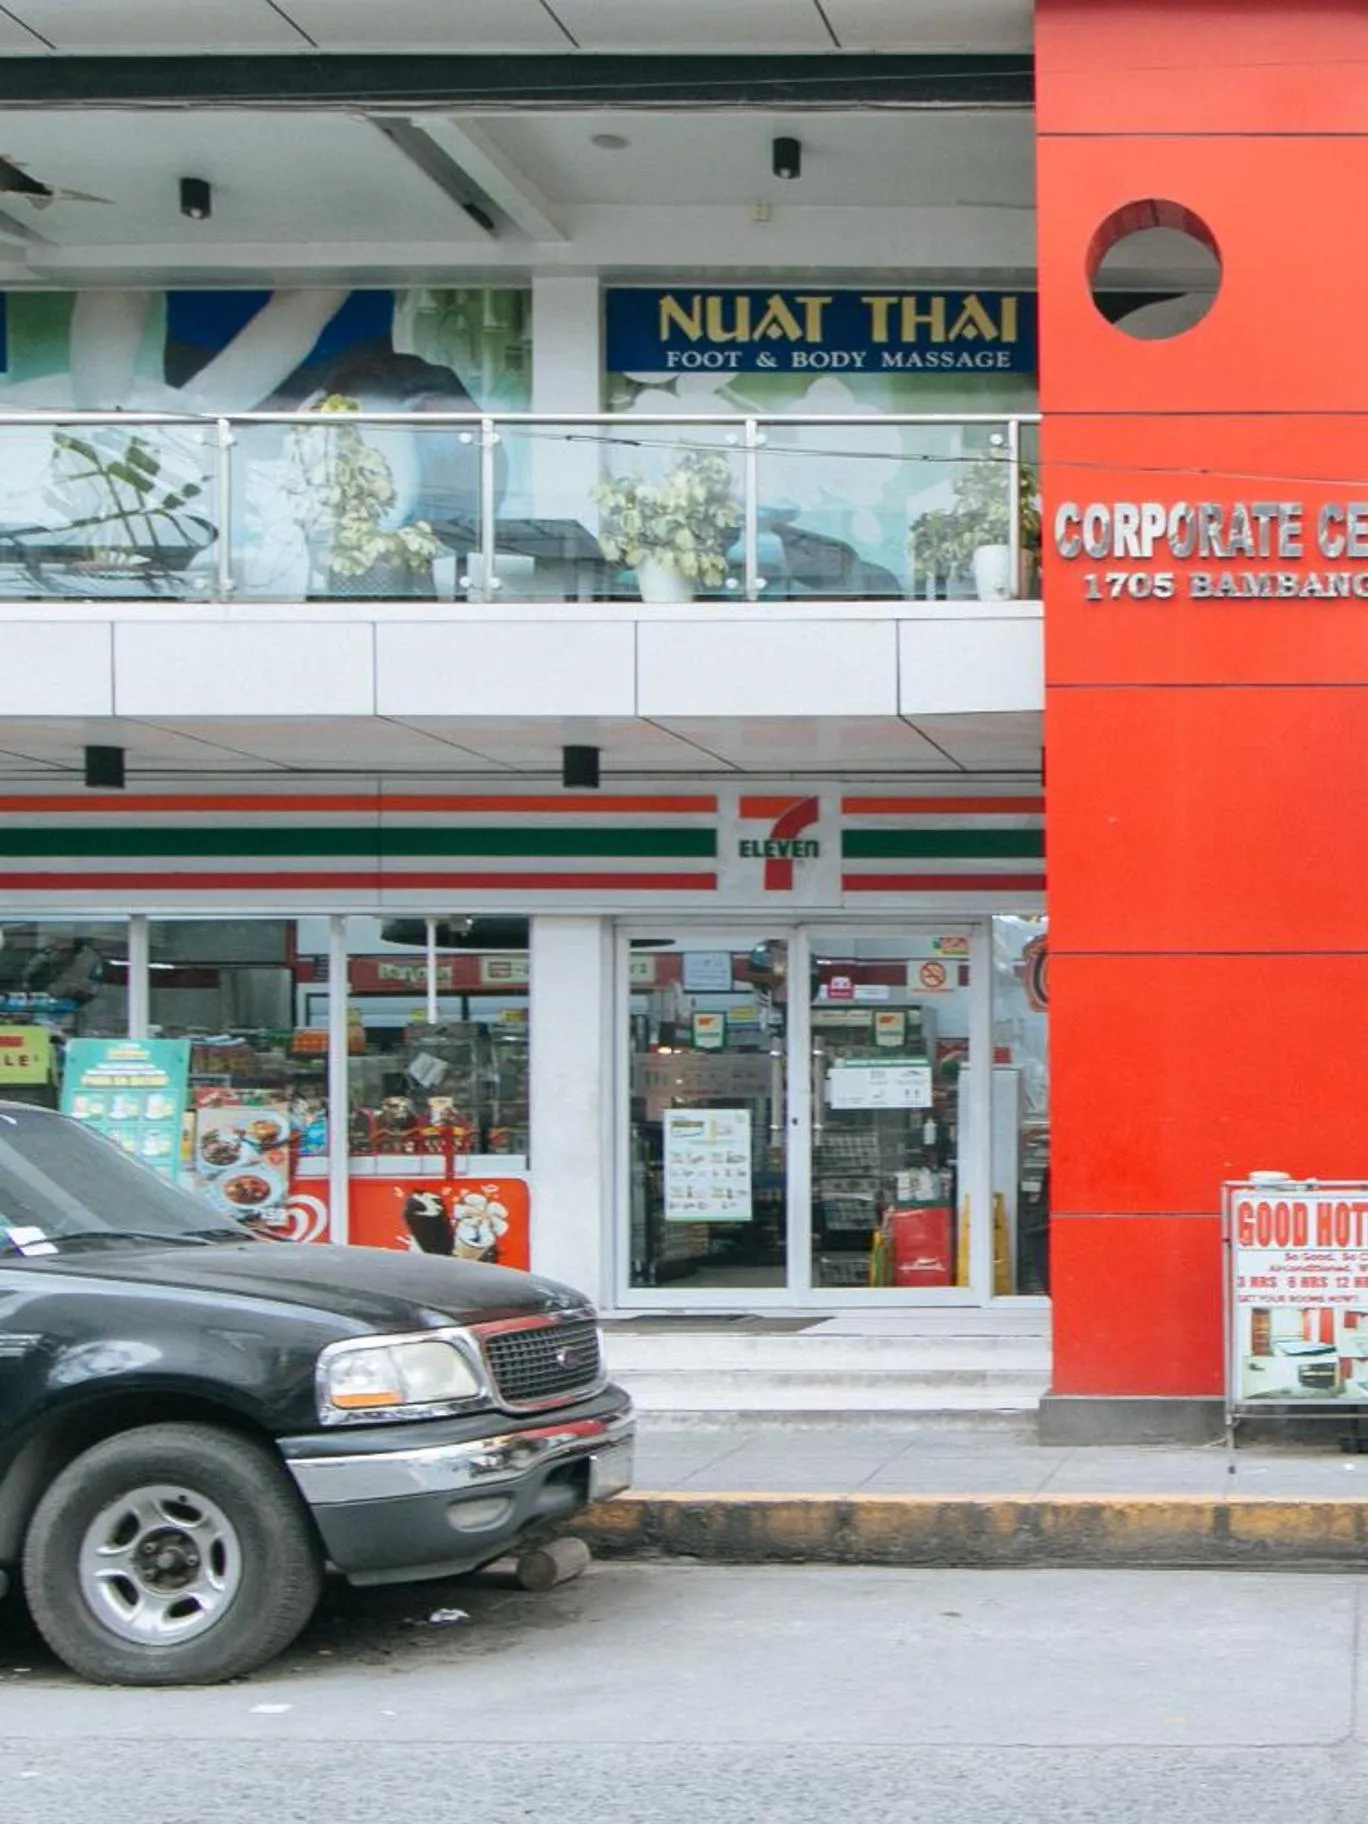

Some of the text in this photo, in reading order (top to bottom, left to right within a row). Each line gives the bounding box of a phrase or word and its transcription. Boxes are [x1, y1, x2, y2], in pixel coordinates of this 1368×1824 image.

[658, 293, 1019, 343] NUAT THAI
[666, 351, 1012, 368] FOOT & BODY MASSAGE
[1053, 502, 1302, 558] CORPORATE
[1083, 572, 1175, 600] 1705
[1237, 1201, 1308, 1248] GOOD
